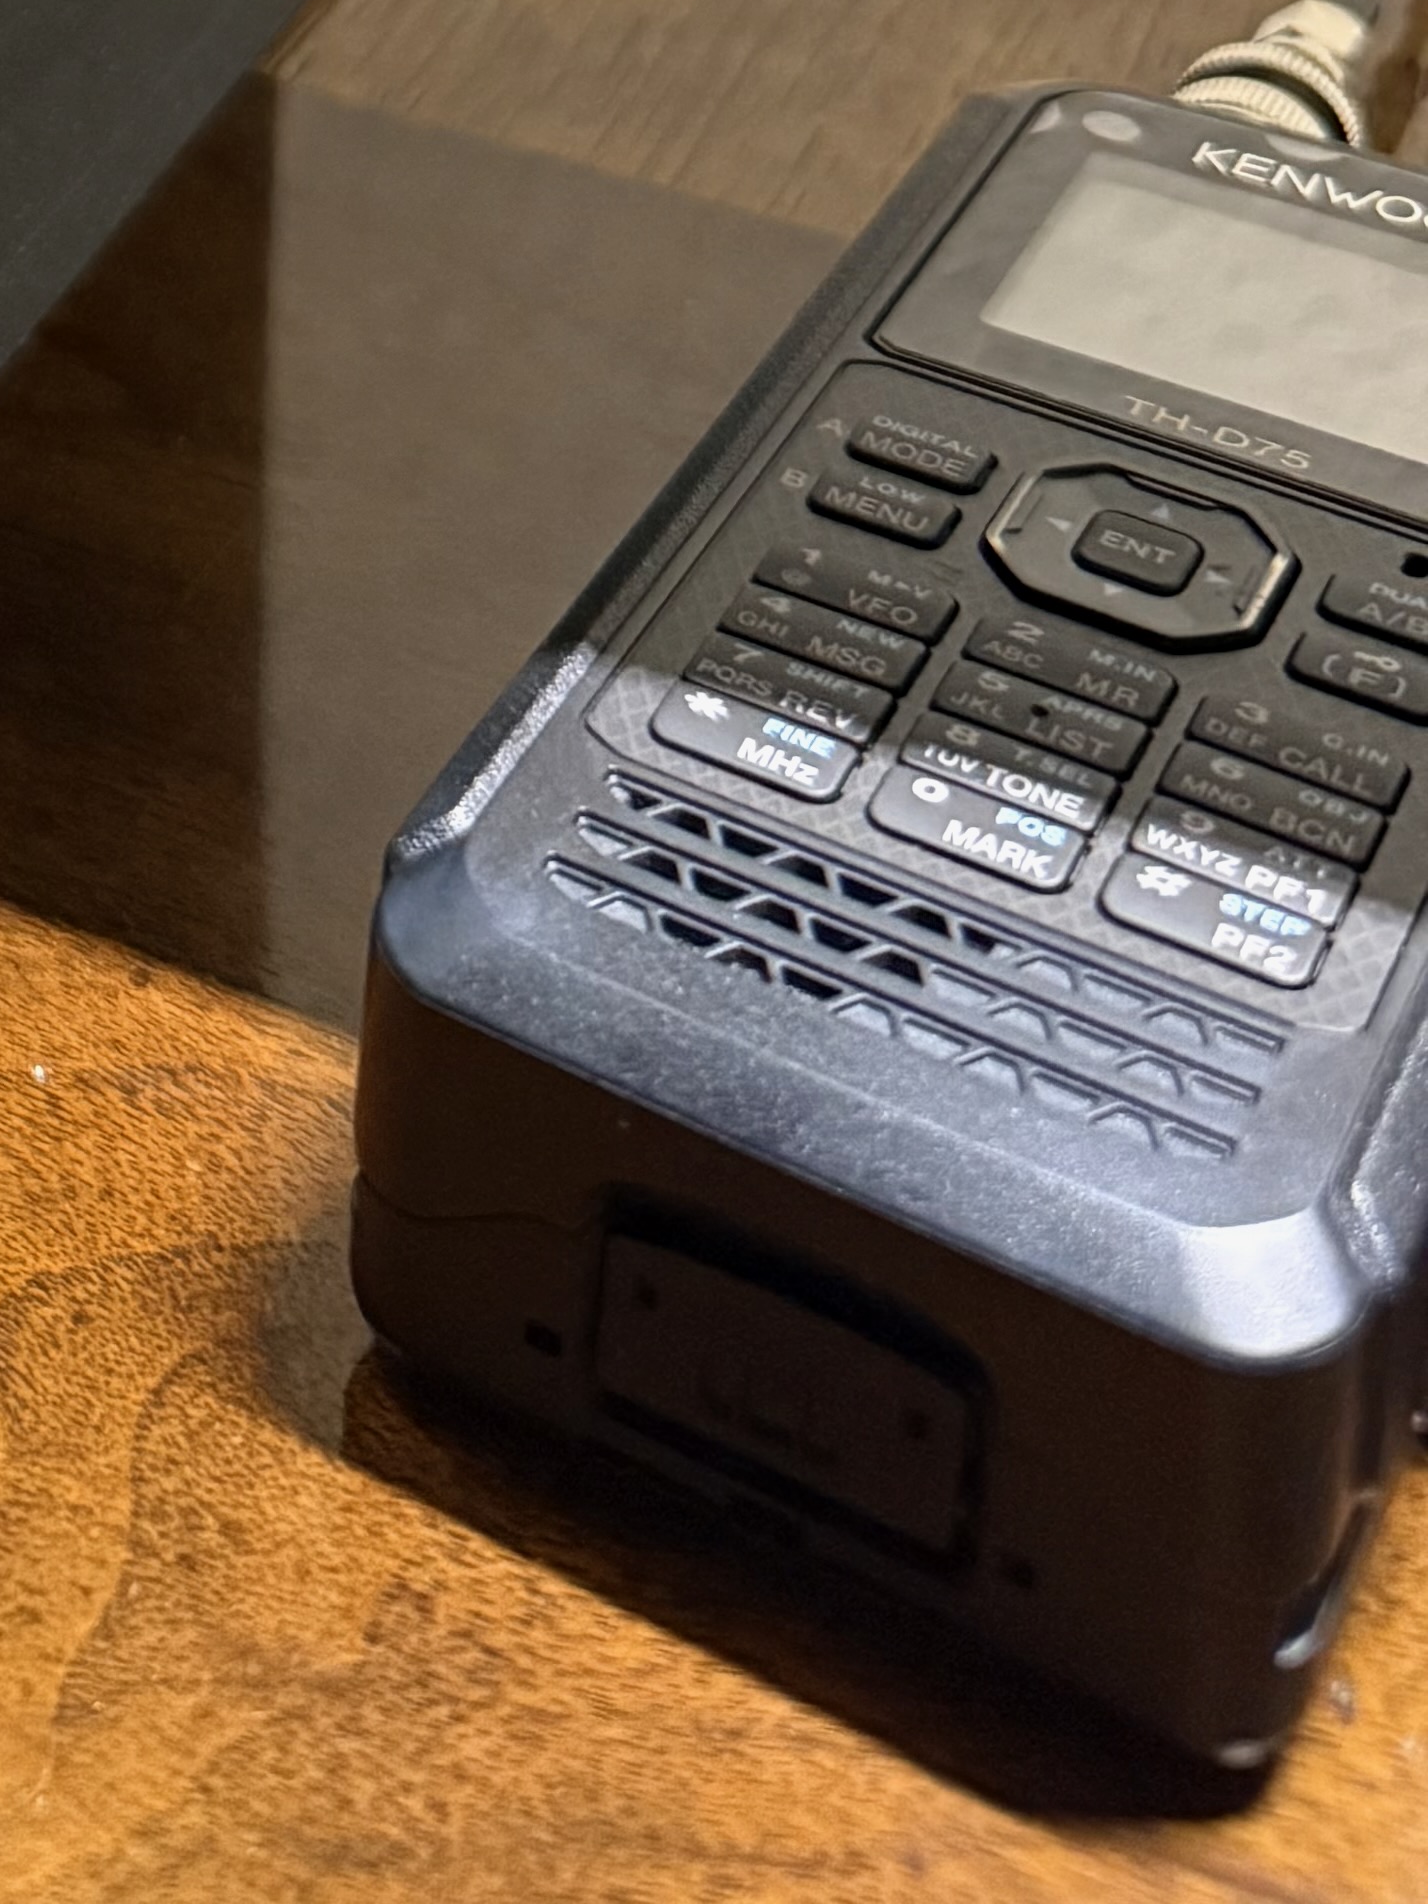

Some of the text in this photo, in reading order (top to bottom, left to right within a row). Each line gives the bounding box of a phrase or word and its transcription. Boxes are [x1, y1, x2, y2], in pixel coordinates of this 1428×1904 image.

[1191, 141, 1428, 228] KENWO
[872, 415, 980, 458] DIGITAL
[1125, 395, 1313, 472] TH-D75
[860, 431, 967, 478] MODE
[780, 468, 808, 489] B
[860, 476, 927, 504] LOW
[825, 487, 930, 533] MENU
[802, 548, 823, 566] 1
[1099, 522, 1177, 565] ENT
[737, 611, 789, 638] GHI
[760, 597, 792, 615] 4
[846, 589, 919, 626] VFO
[837, 620, 905, 650] NEW
[1007, 621, 1045, 643] 2
[806, 636, 887, 678] MSG
[982, 640, 1043, 669] ABC
[695, 658, 773, 697] PQRS
[786, 662, 867, 699] SHIFT
[1075, 672, 1141, 709] MR
[778, 690, 859, 730] REV
[762, 718, 836, 759] FINE
[1027, 718, 1116, 759] LIST
[737, 737, 819, 787] MHz
[1279, 747, 1372, 793] CALL
[983, 763, 1086, 818] TONE
[1182, 774, 1252, 811] MNO
[942, 819, 1054, 879] MARK
[1147, 824, 1242, 876] WXYZ
[1270, 806, 1355, 854] BCN
[1219, 893, 1313, 936] STEP
[1211, 923, 1298, 974] PF2
